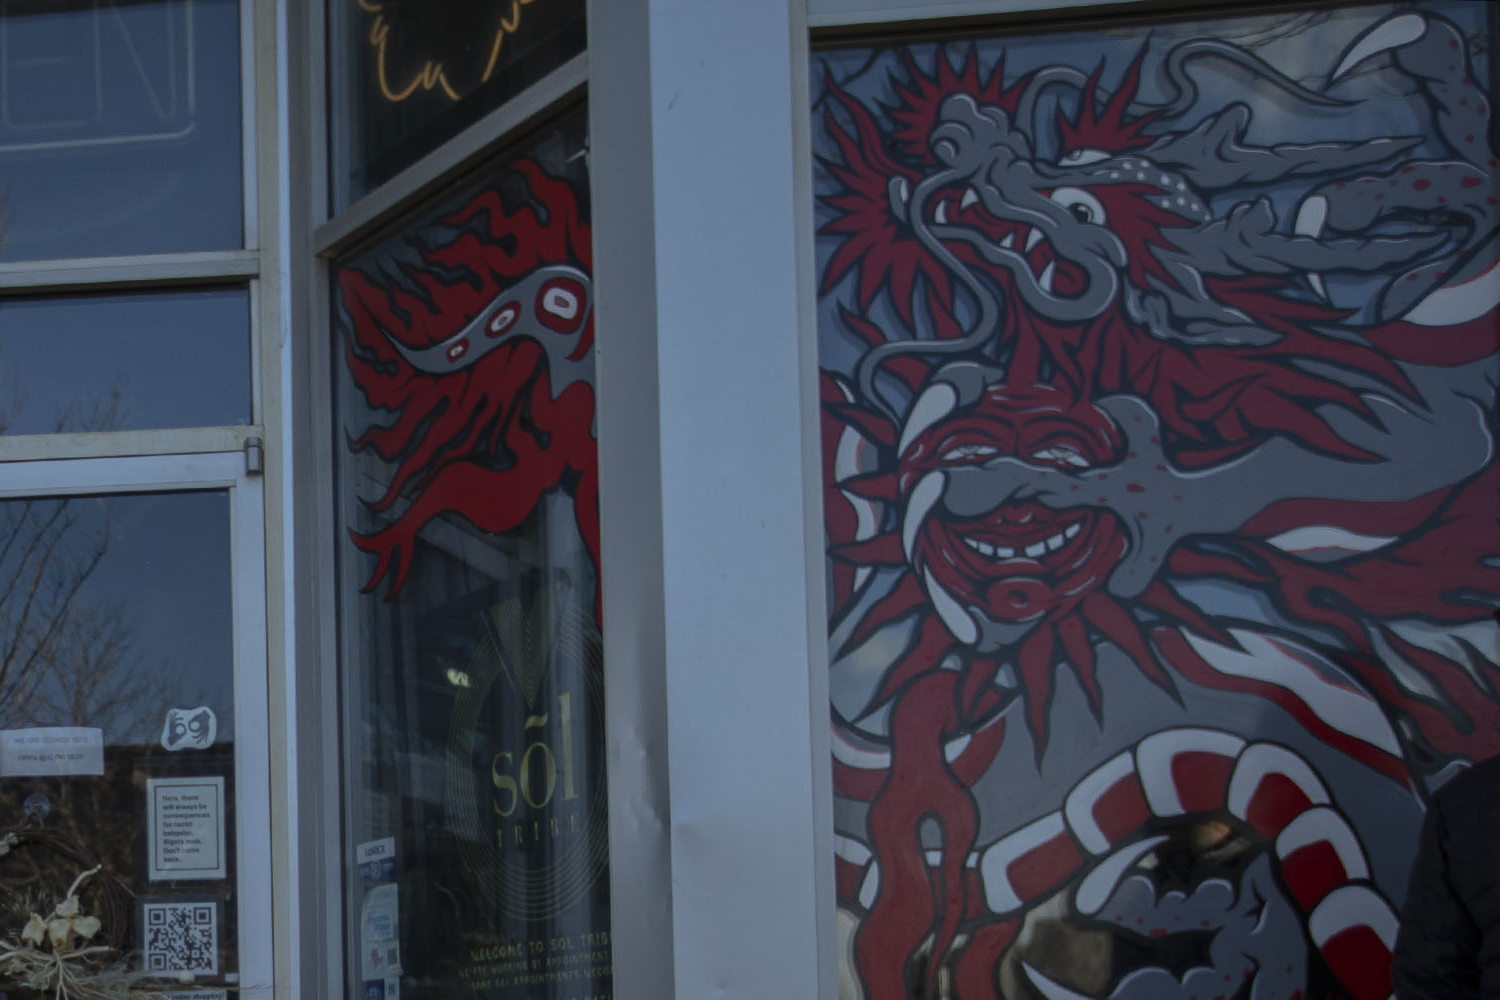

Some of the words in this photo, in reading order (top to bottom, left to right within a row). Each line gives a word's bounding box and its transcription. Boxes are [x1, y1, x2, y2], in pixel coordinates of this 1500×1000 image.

[497, 813, 580, 848] TRIBE
[469, 943, 524, 960] WELCOME
[529, 940, 544, 953] TO
[550, 936, 573, 951] SOL
[580, 931, 612, 947] TRIB
